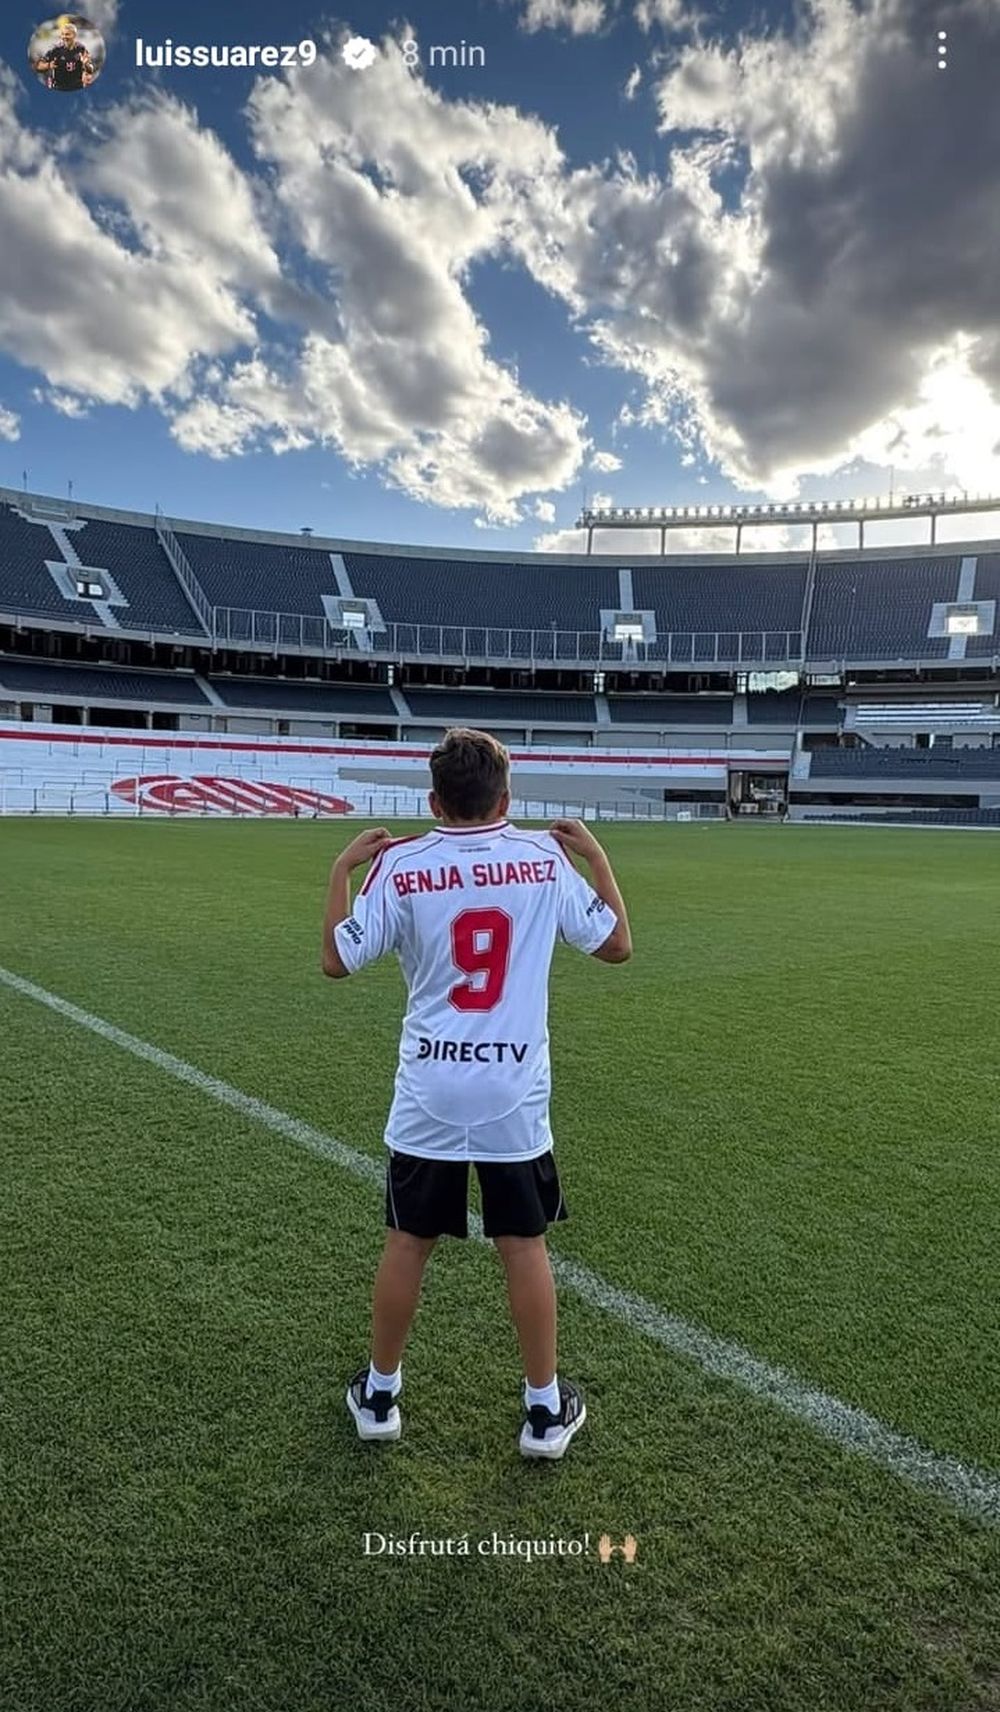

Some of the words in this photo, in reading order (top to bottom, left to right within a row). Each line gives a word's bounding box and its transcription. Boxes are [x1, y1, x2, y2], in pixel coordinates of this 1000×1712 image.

[393, 866, 464, 897] BENJA
[473, 859, 557, 888] SUAREZ
[447, 906, 513, 1013] 9
[416, 1038, 528, 1063] DIRECTV
